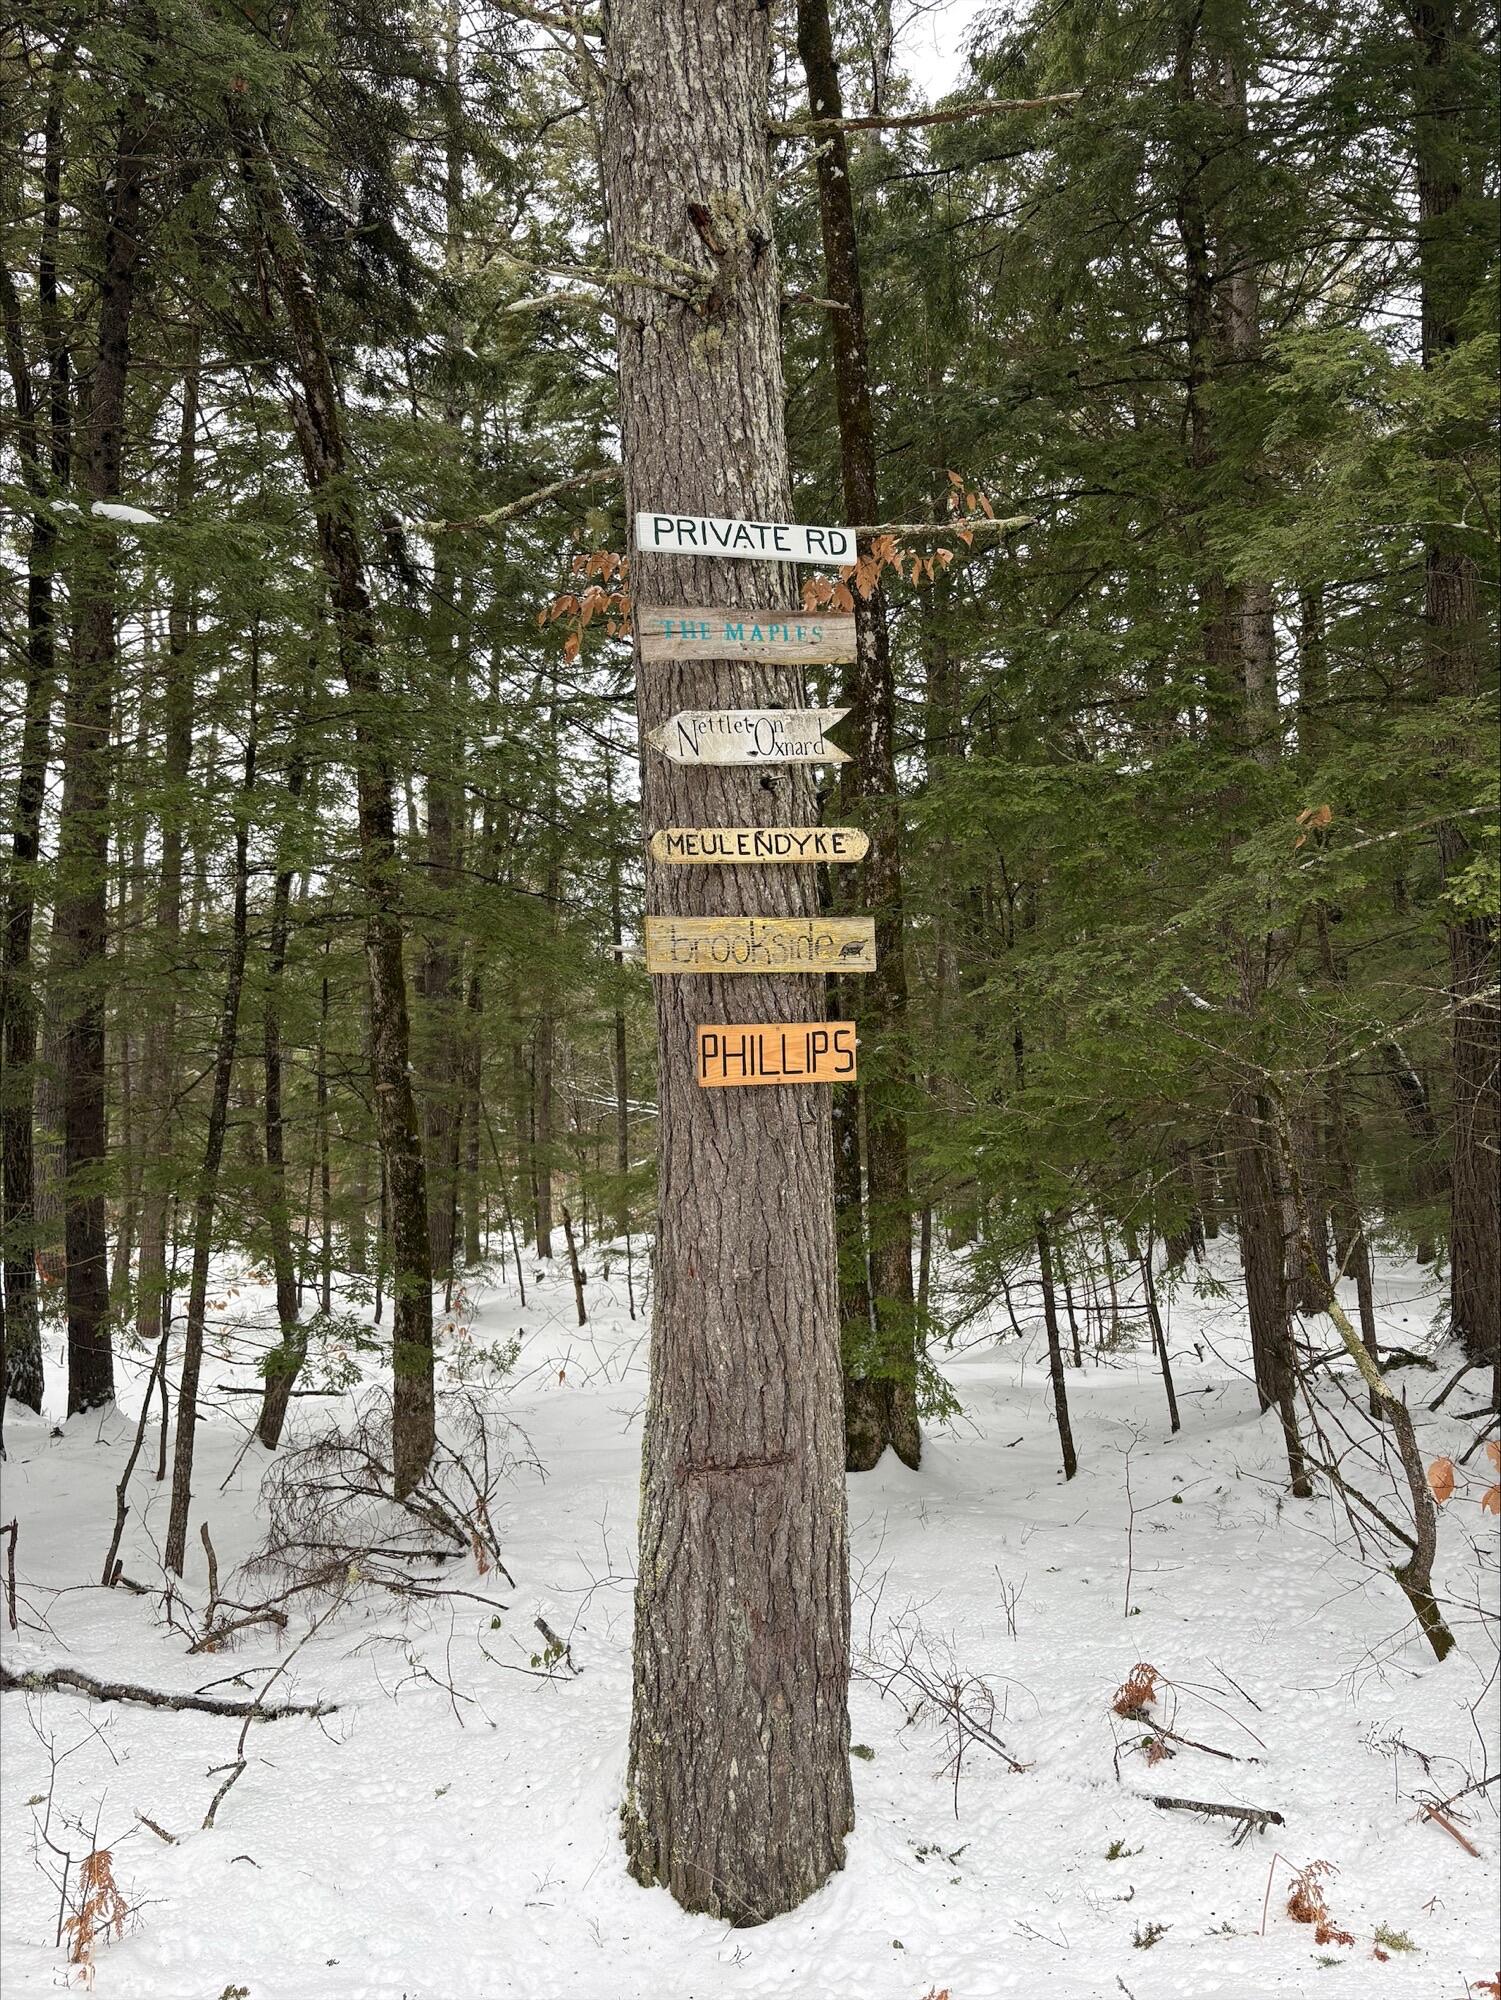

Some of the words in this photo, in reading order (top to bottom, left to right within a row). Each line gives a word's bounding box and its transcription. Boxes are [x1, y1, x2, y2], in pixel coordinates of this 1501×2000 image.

[653, 517, 791, 551] PRIVATE
[806, 528, 847, 556] RD
[657, 619, 711, 641] THE
[723, 622, 824, 642] MAPLES
[667, 832, 846, 856] MEULENDYKE
[702, 1030, 854, 1078] PHILLIPS
